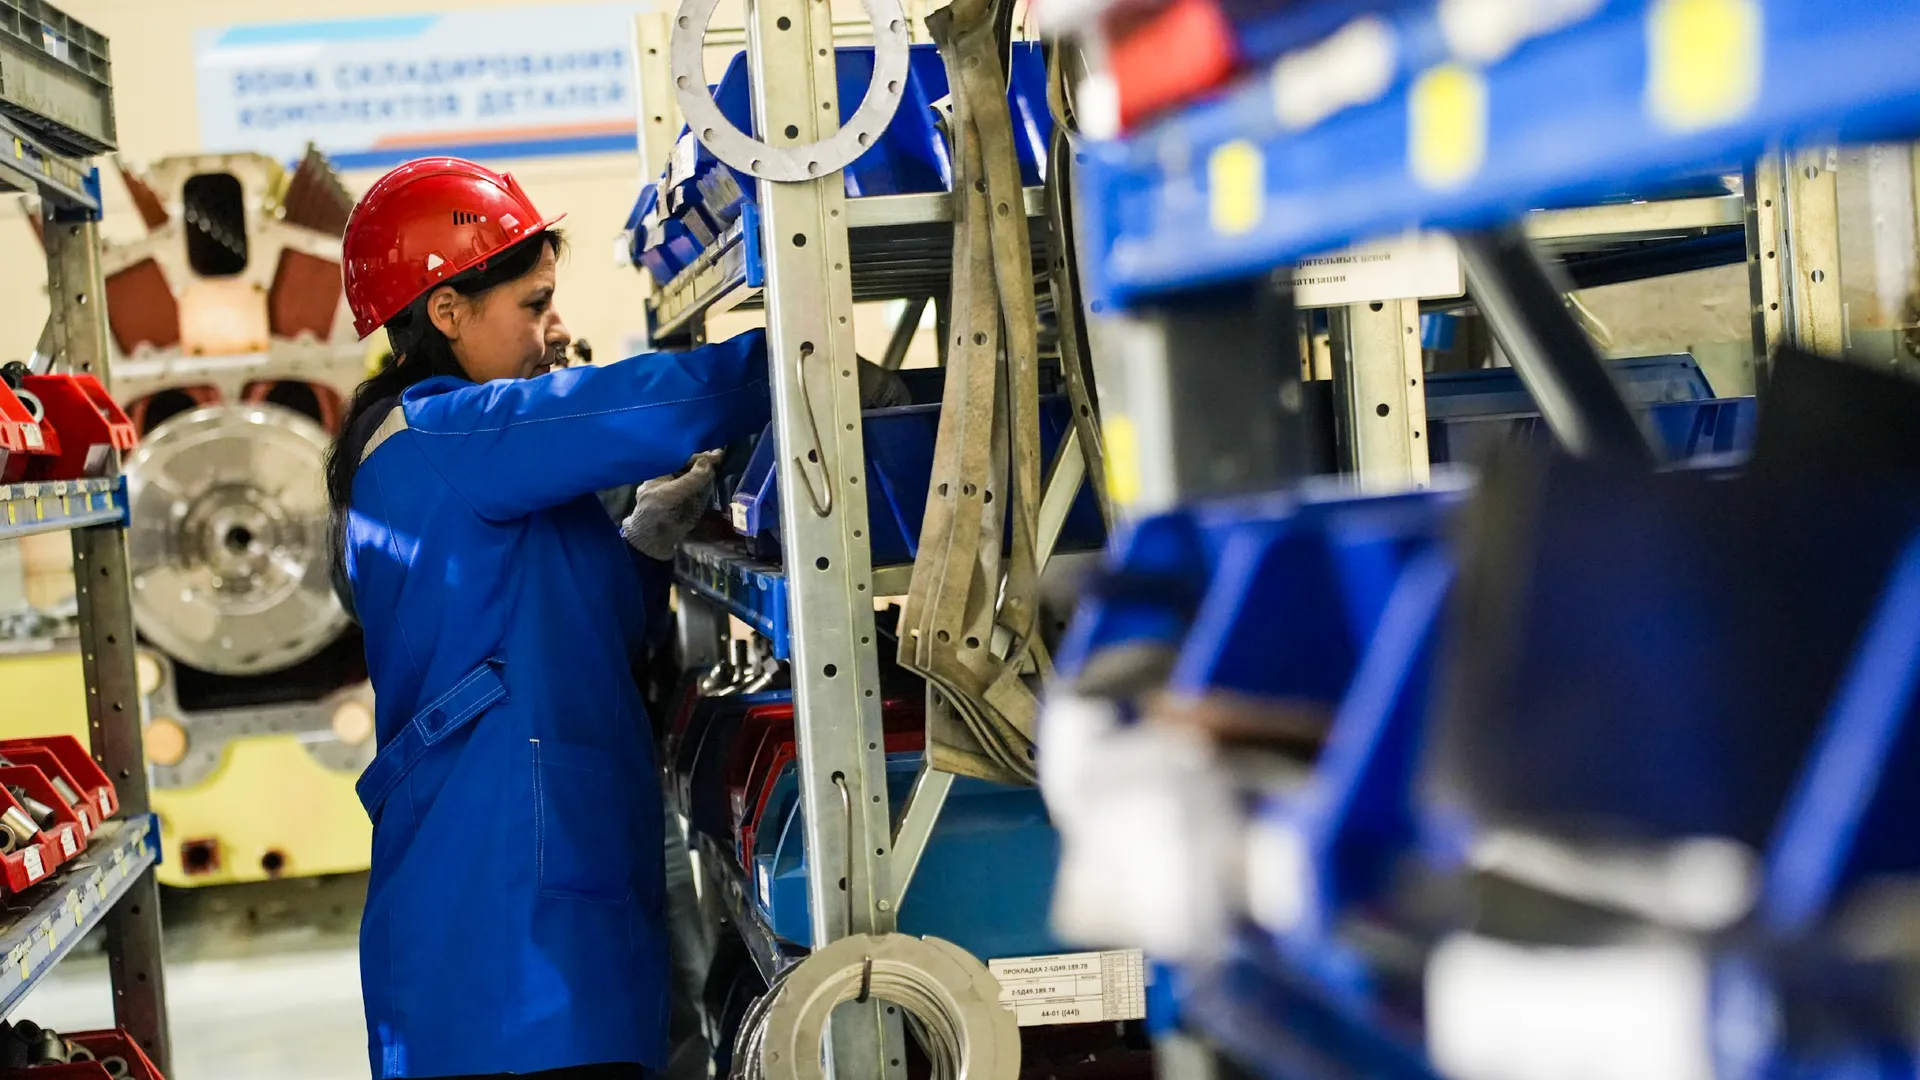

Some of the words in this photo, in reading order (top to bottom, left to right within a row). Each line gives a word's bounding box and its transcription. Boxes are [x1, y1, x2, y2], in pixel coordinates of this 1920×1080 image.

[235, 68, 315, 96] ЗОНА
[334, 48, 625, 91] СКЛАДИРОВАНИЯ
[239, 92, 461, 130] КОМПЛЕКТОВ
[476, 81, 626, 117] ДЕТАЛЕЙ
[1295, 255, 1357, 270] рительных
[1003, 966, 1042, 975] ПРОКЛАДКА
[1044, 963, 1088, 972] 2-5Д49.189.78
[1011, 987, 1055, 996] 2-5Д49.189.78
